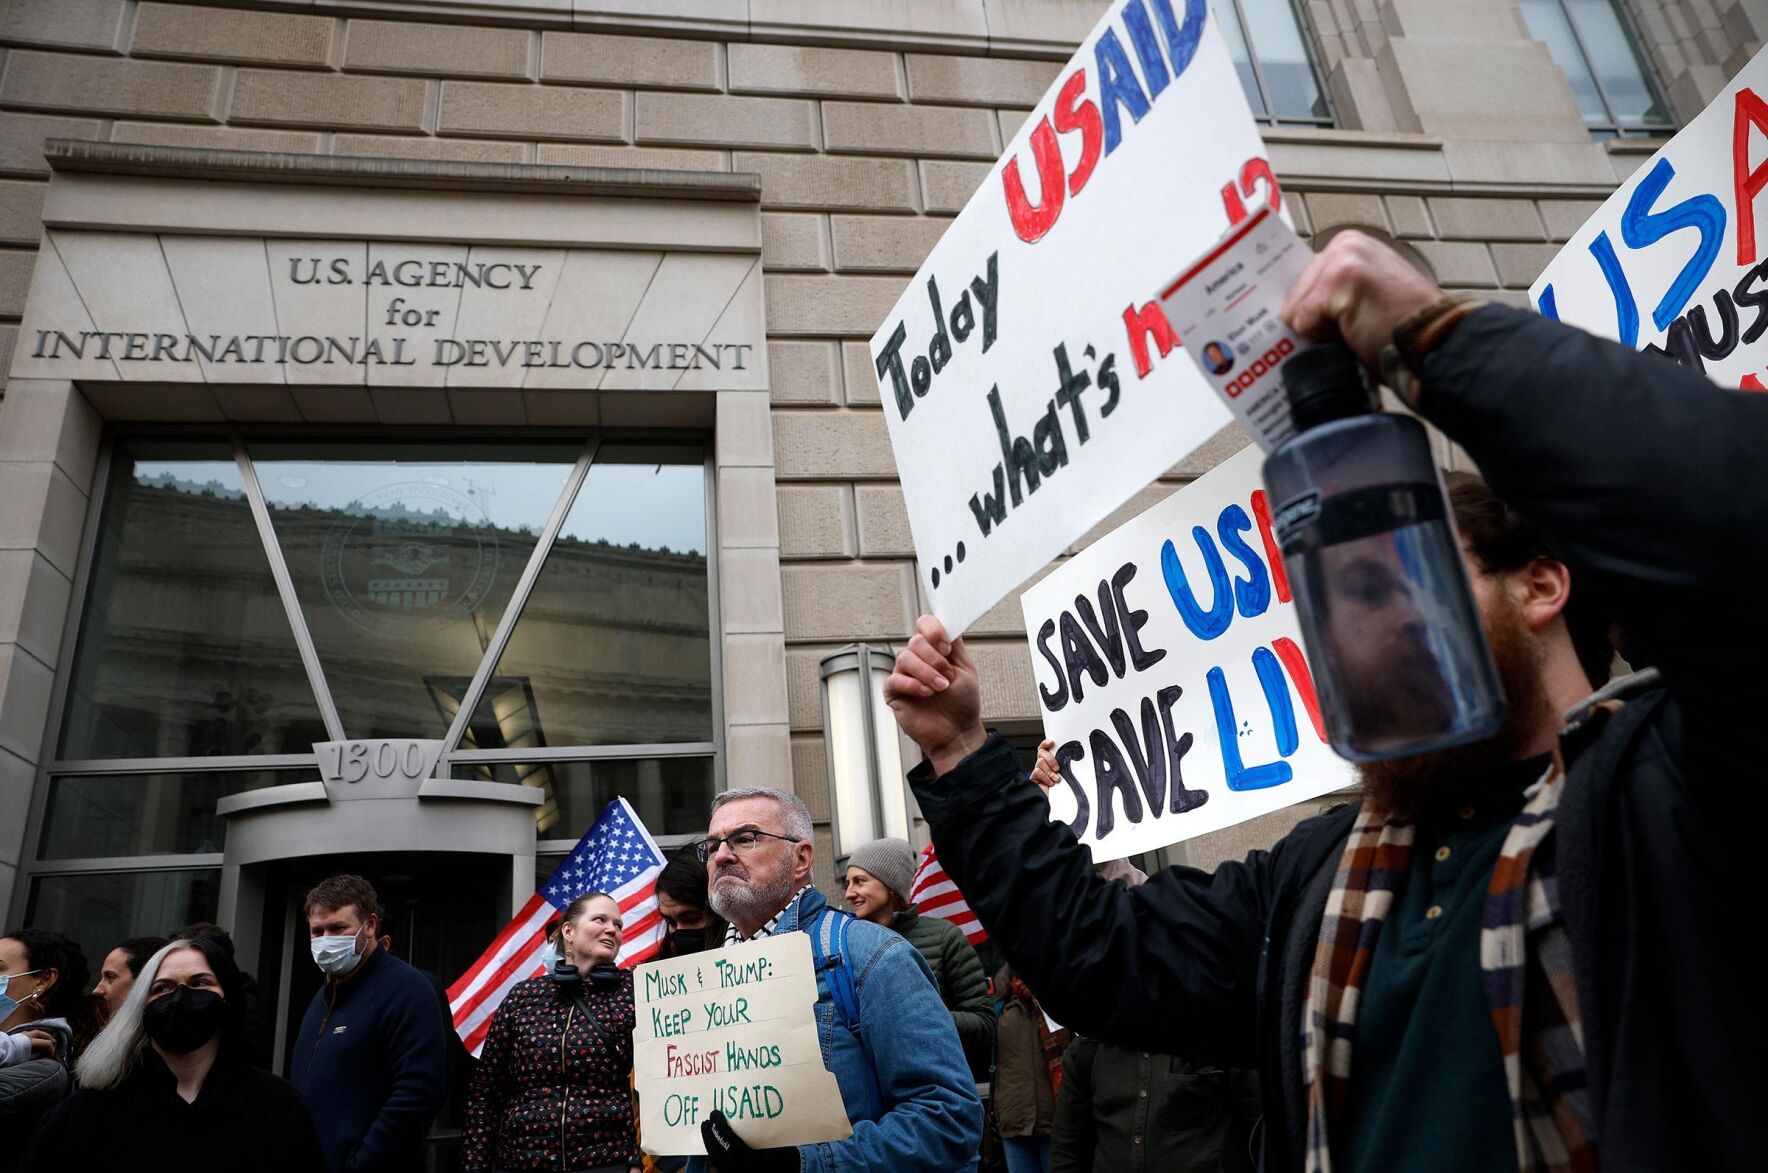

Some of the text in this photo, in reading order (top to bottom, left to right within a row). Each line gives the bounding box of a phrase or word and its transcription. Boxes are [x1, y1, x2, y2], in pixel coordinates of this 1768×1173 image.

[875, 0, 1208, 421] Today USAID
[288, 258, 542, 290] U.S. AGENCY
[1205, 262, 1244, 295] America
[385, 298, 440, 327] for
[31, 329, 752, 370] INTERNATIONAL DEVELOPMENT
[1037, 562, 1167, 712] SAVE
[327, 742, 425, 784] 1300
[1055, 685, 1209, 841] SAVE
[645, 957, 773, 1003] MUSK & TRUMP:
[652, 997, 752, 1038] KEEP YOUR
[666, 1041, 782, 1078] FASCIST HANDS
[664, 1085, 784, 1127] OFF USAID
